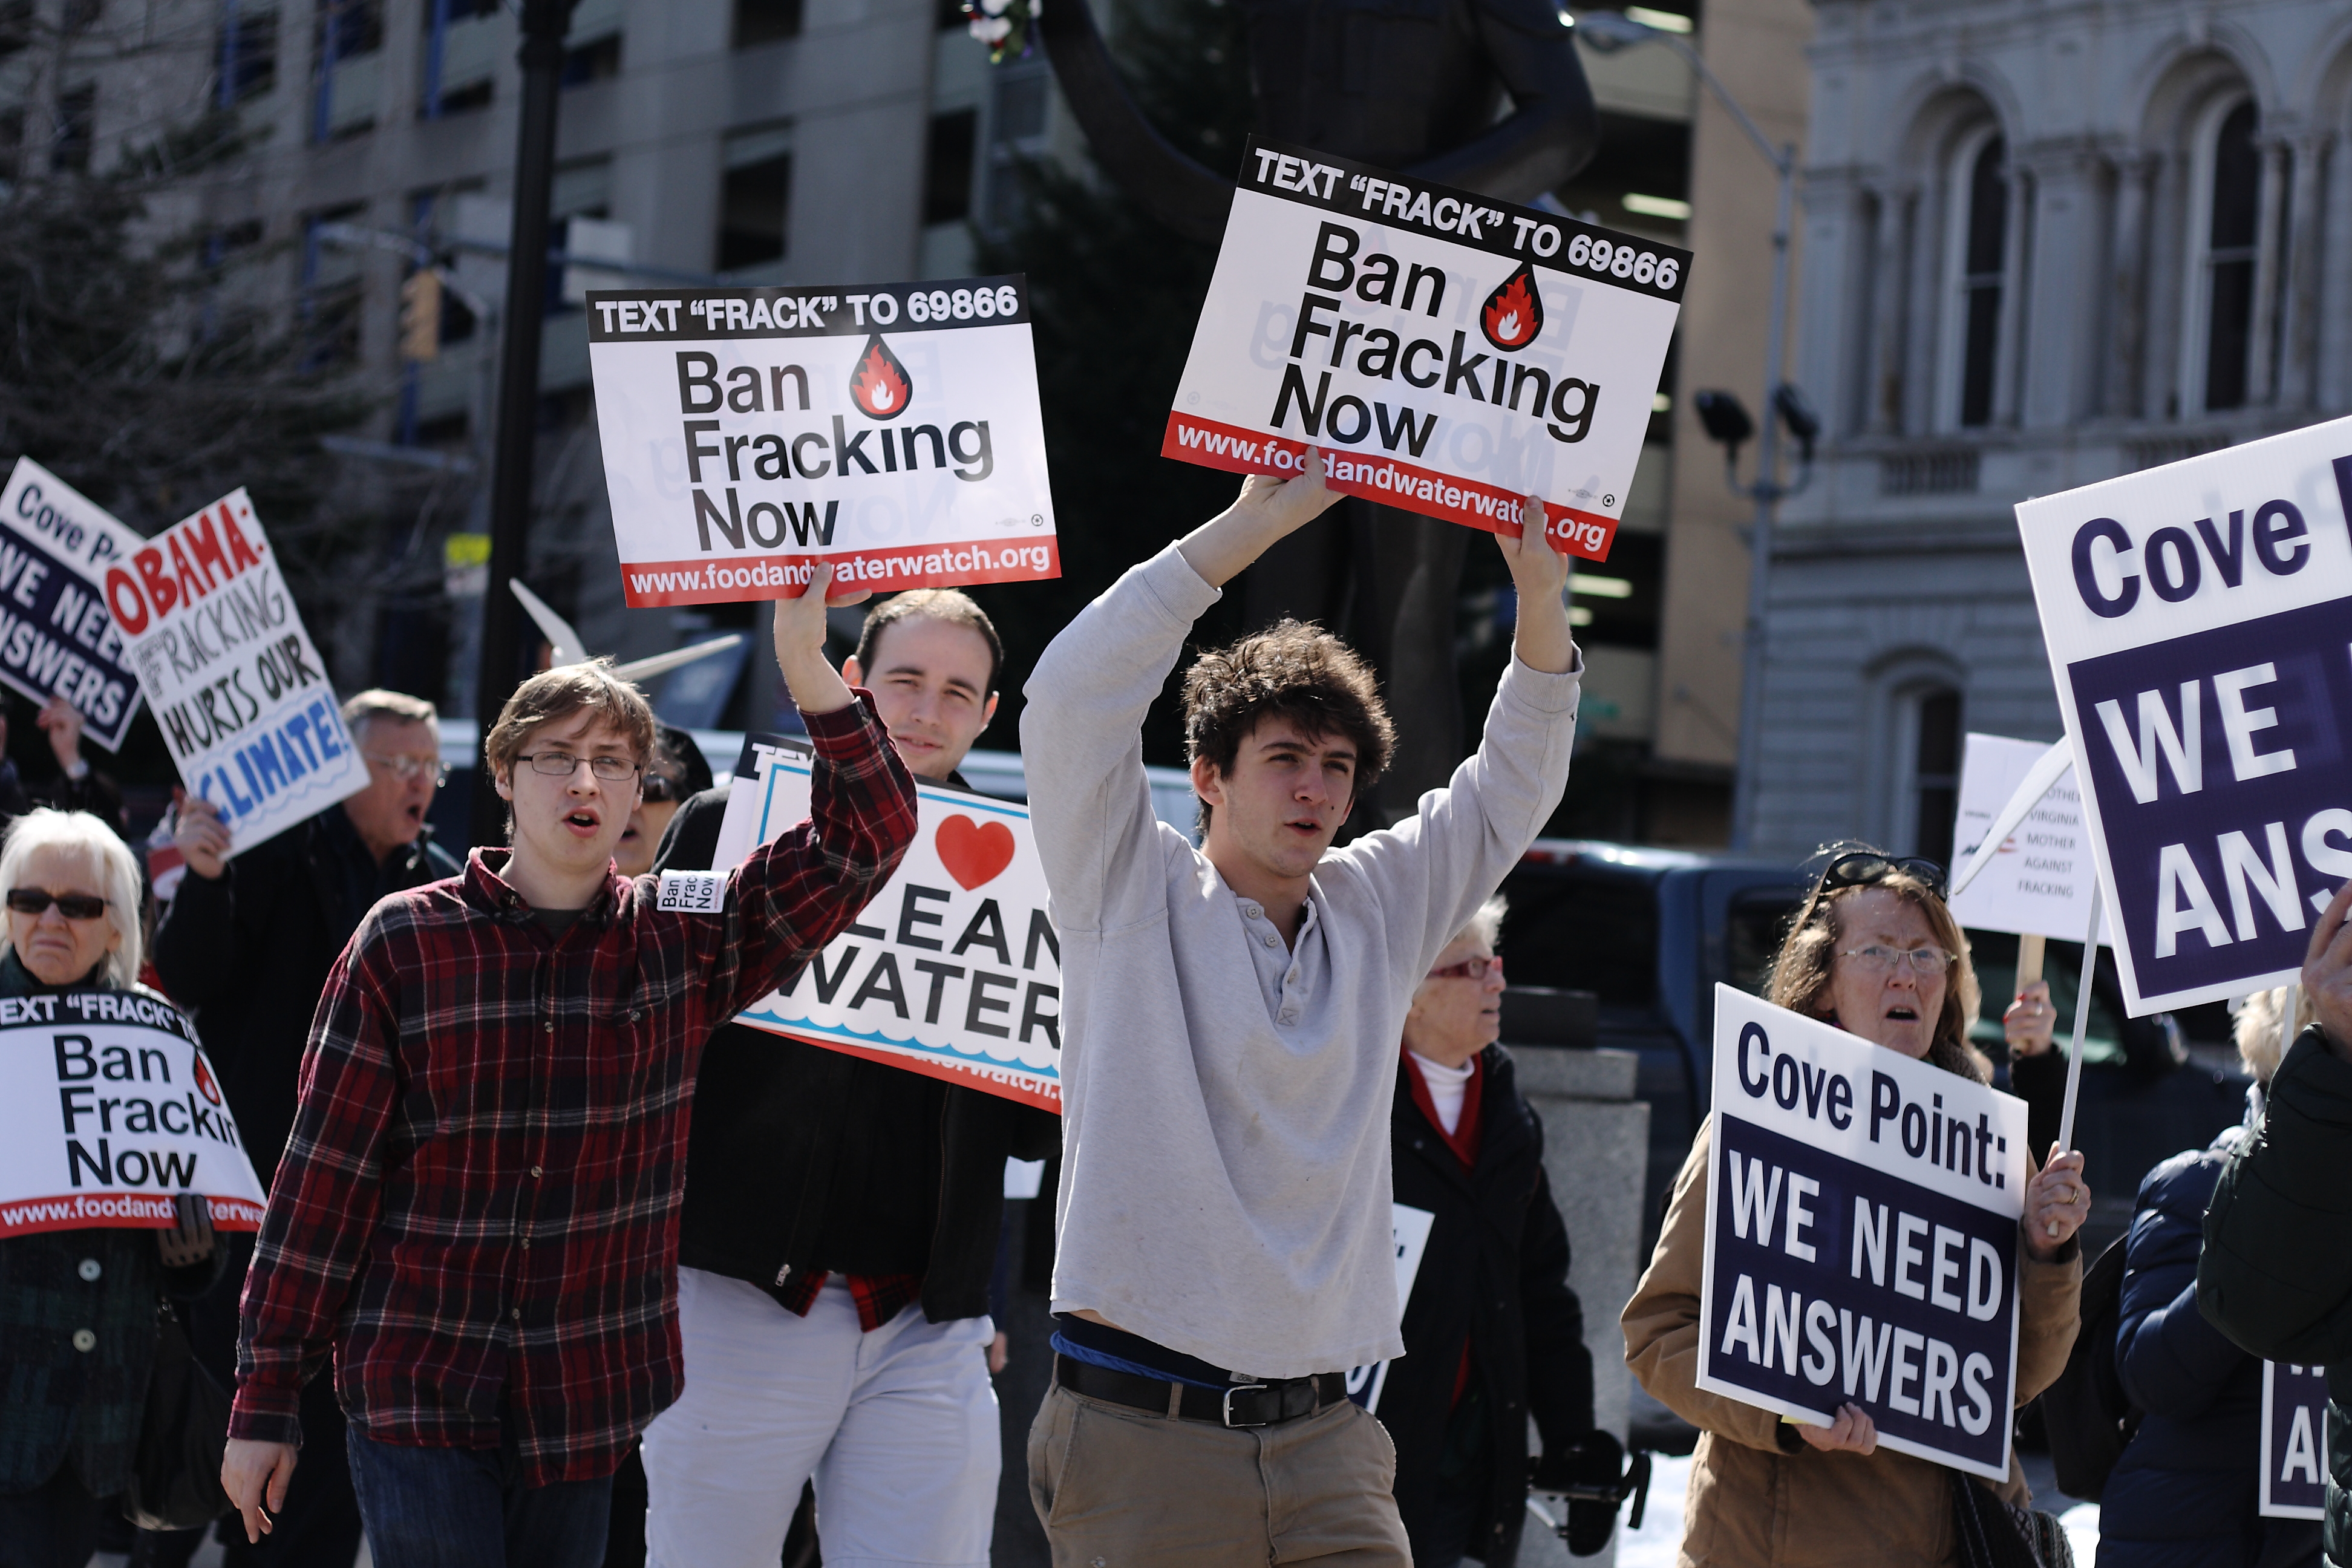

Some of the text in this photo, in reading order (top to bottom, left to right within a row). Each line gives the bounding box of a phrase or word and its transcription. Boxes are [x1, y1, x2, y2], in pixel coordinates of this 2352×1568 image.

[1255, 147, 1680, 291] TEXT “FRACK” TO 69866
[1306, 220, 1446, 318] Ban
[595, 285, 1019, 334] TEXT “FRACK” TO 69866
[676, 350, 811, 416] Ban
[1290, 291, 1601, 443] Fracking
[1270, 362, 1439, 459] Now
[683, 415, 994, 483] Fracking
[17, 485, 83, 552] Cove
[691, 488, 840, 552] Now
[106, 500, 266, 636] OBAMA:
[630, 545, 1050, 594] www.foodandaterwatch.org
[2071, 498, 2312, 619] Cove
[162, 668, 258, 757] HURTS
[257, 633, 321, 702] OUR
[2094, 662, 2297, 805] WE
[2027, 831, 2076, 849] MOTHER
[2029, 809, 2079, 826] VIRGINIA
[662, 880, 680, 907] Ban
[696, 877, 714, 909] Now
[2018, 880, 2074, 898] FRACKING
[2024, 857, 2074, 874] AGAINST
[53, 1034, 171, 1084] Ban
[1737, 1021, 2006, 1190] Cove Point:
[65, 1138, 197, 1189] Now
[1728, 1149, 2003, 1322] WE NEED
[1720, 1273, 1994, 1437] ANSWERS
